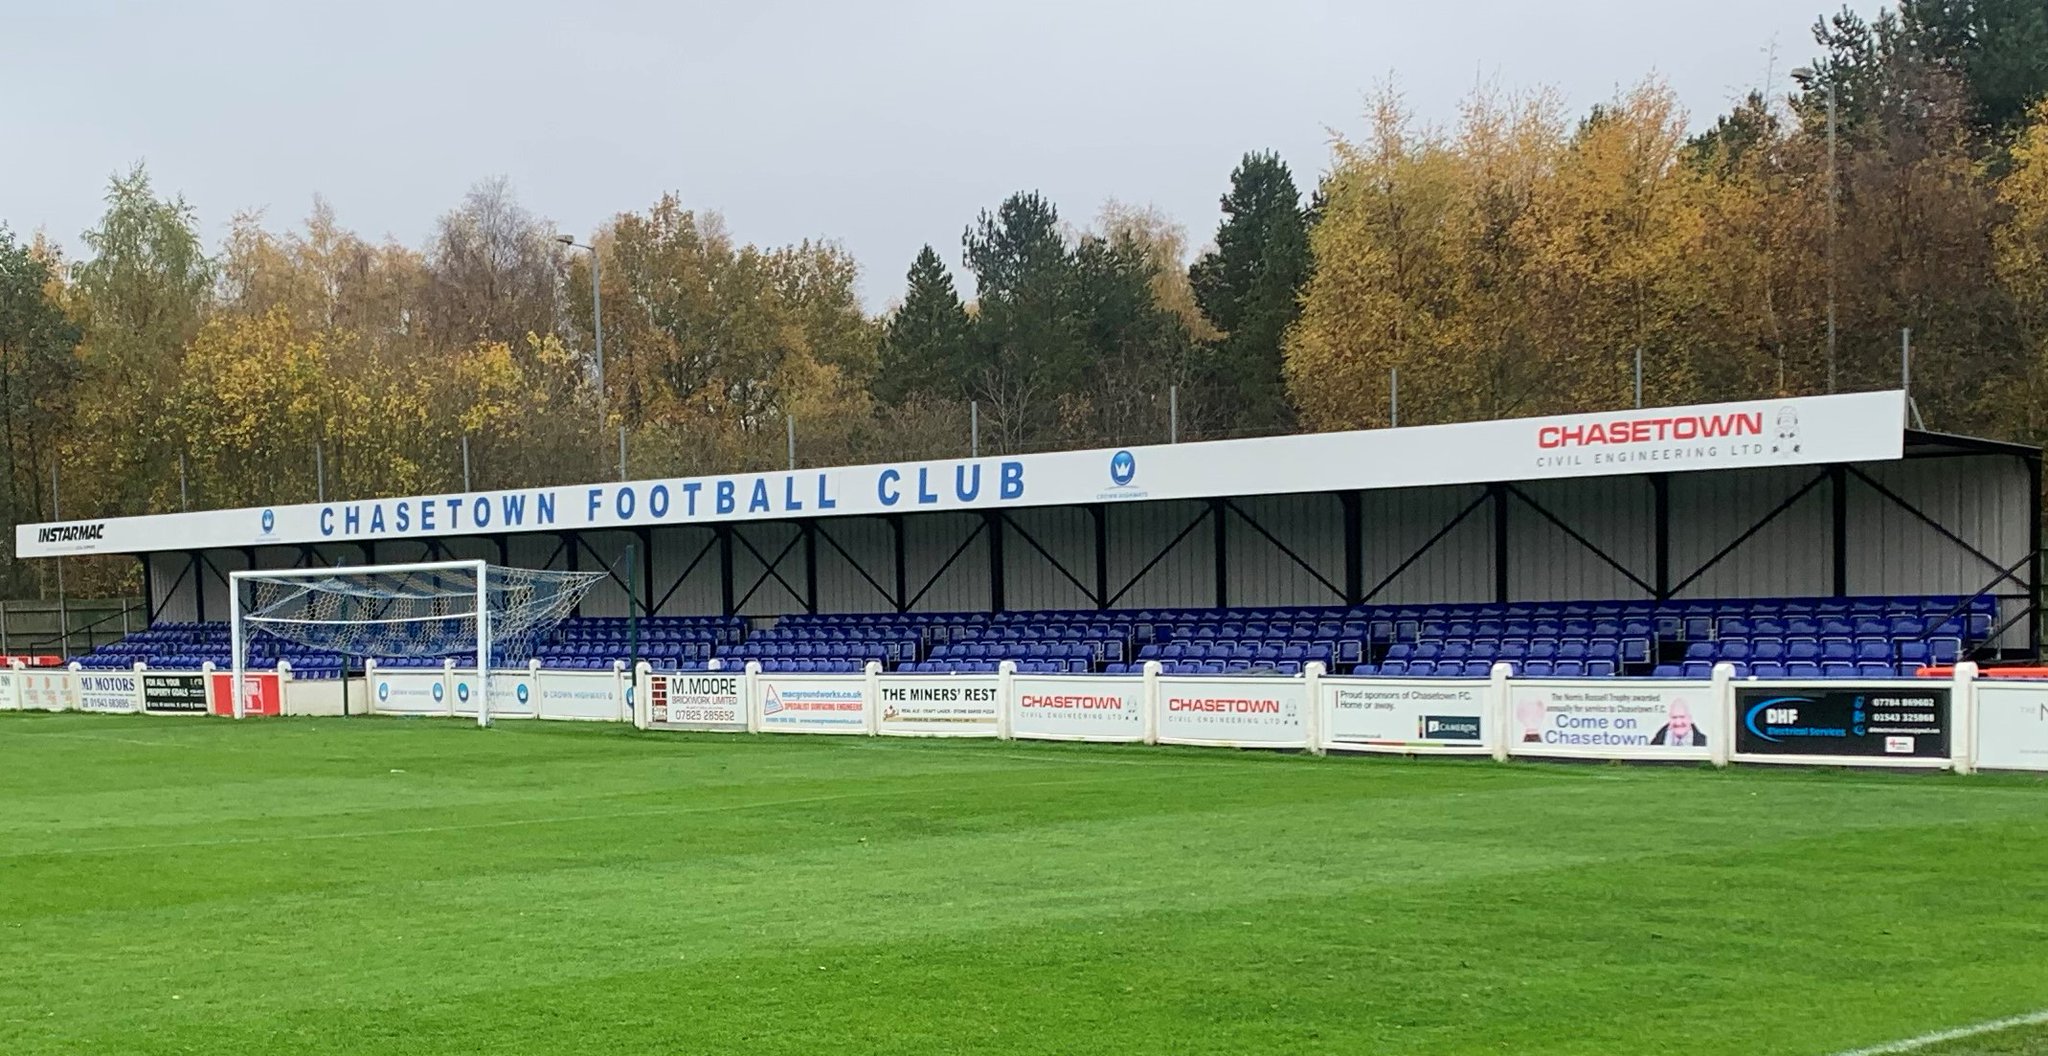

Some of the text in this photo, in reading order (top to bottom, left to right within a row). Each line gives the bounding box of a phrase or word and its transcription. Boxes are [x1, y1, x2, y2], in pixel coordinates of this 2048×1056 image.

[1538, 412, 1763, 448] CHASETOWN
[1536, 443, 1763, 468] CIVIL ENGINEERING LTD
[319, 461, 1025, 536] CHASETOWN FOOTBALL CLUB
[38, 524, 104, 542] INSTARMAC
[81, 678, 135, 691] MJ MOTORS
[166, 679, 180, 687] YOUR
[672, 678, 737, 695] M.MOORE
[147, 688, 171, 697] PROPERTY
[172, 688, 188, 697] GOALS
[882, 689, 997, 701] THE MINERS' REST
[1340, 690, 1362, 699] Proud
[1364, 692, 1400, 700] sponsors
[1402, 691, 1410, 699] of
[1411, 691, 1456, 700] Chasetown
[1609, 693, 1630, 702] Trophy
[672, 696, 737, 705] BRICKWORK LIMITED
[1022, 696, 1121, 709] CHASETOWN
[1169, 699, 1279, 713] CHASETOWN
[1340, 701, 1362, 709] Home
[1617, 705, 1653, 713] Chasetown
[1556, 714, 1637, 729] Come on
[1765, 708, 1798, 724] DHF
[1873, 713, 1899, 721] 01543
[1545, 730, 1649, 745] Chasetown
[1766, 727, 1808, 735] Electrical
